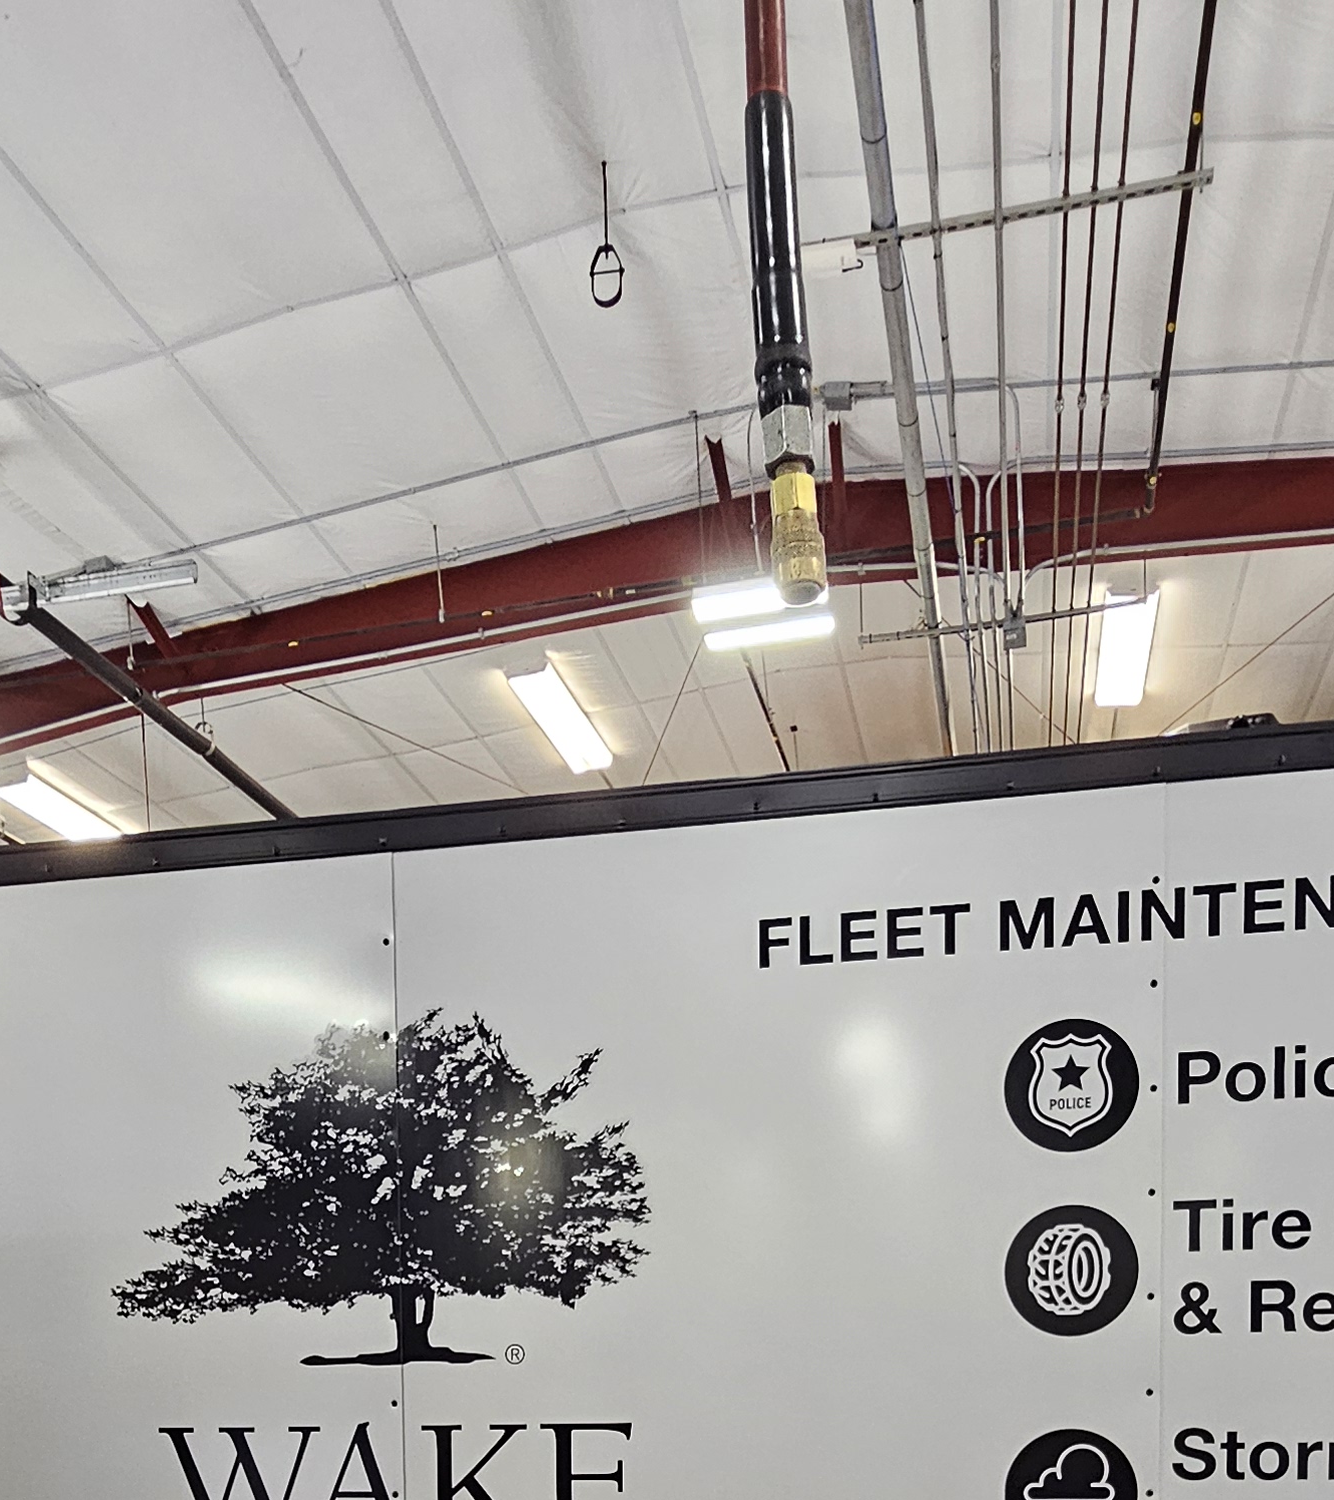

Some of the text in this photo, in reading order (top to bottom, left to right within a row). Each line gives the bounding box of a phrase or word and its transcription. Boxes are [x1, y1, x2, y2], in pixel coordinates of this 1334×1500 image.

[758, 903, 971, 969] FLEET
[1049, 1096, 1092, 1110] POLICE
[1173, 1198, 1312, 1253] Tire
[1173, 1281, 1223, 1336] &
